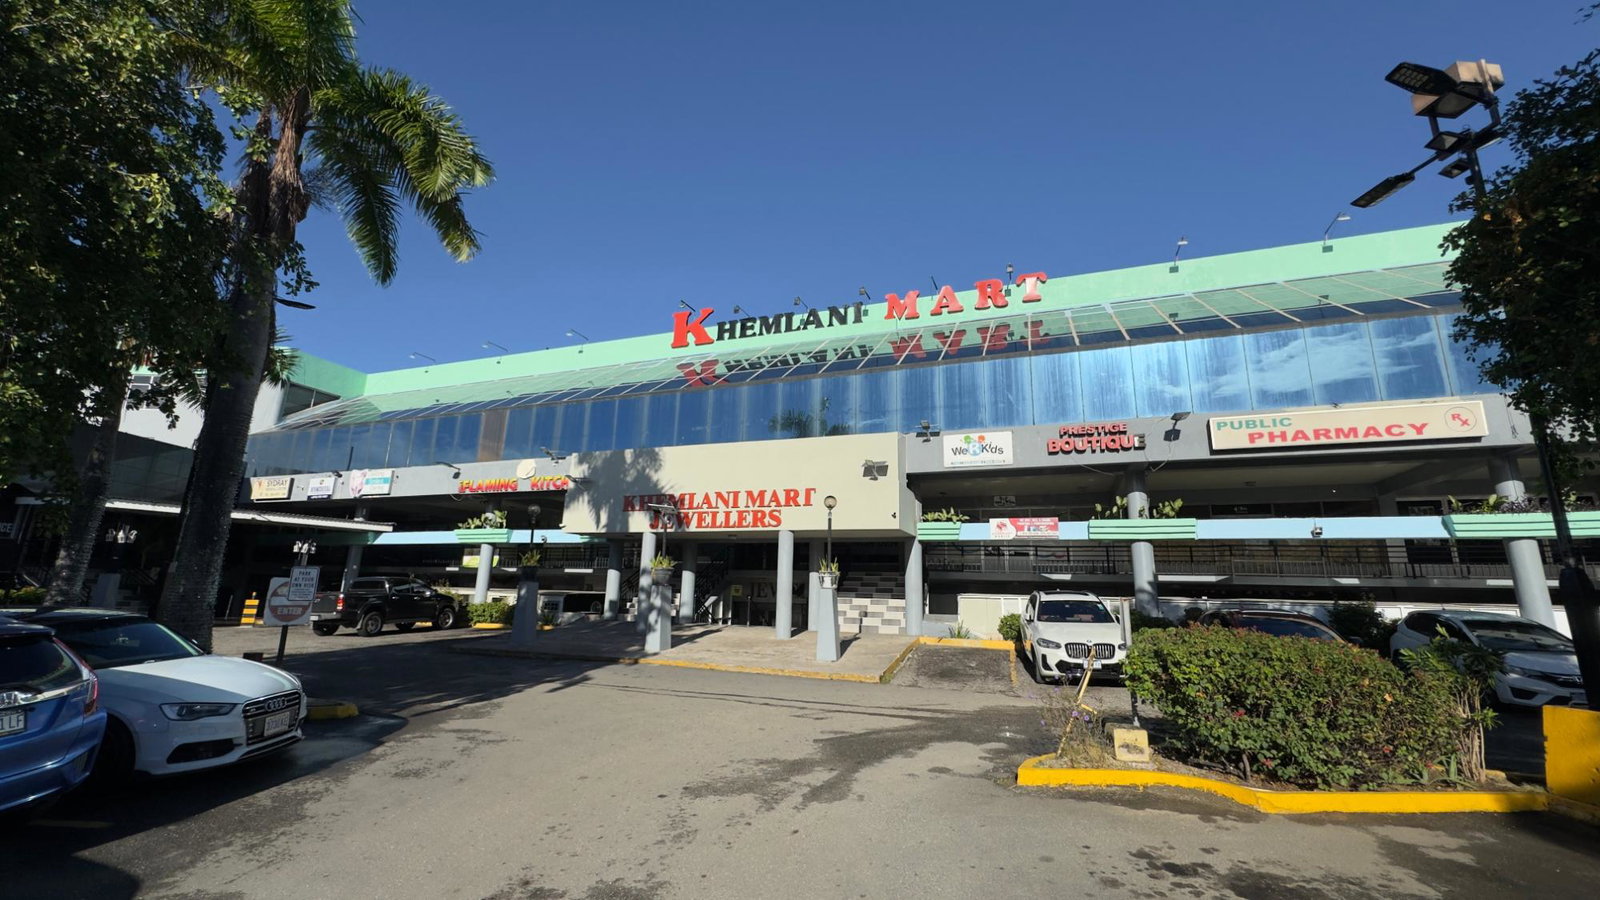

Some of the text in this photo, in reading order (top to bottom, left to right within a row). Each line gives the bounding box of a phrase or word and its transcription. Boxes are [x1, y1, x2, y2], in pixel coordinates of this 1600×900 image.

[671, 271, 1048, 348] KHEMLANI MART
[1059, 422, 1128, 437] PRESTIGE
[1216, 417, 1292, 431] PUBLIC
[1247, 423, 1429, 444] PHARMACY
[1047, 434, 1146, 453] BOUTIQUE
[459, 478, 518, 493] FLAMING
[745, 488, 816, 508] MART
